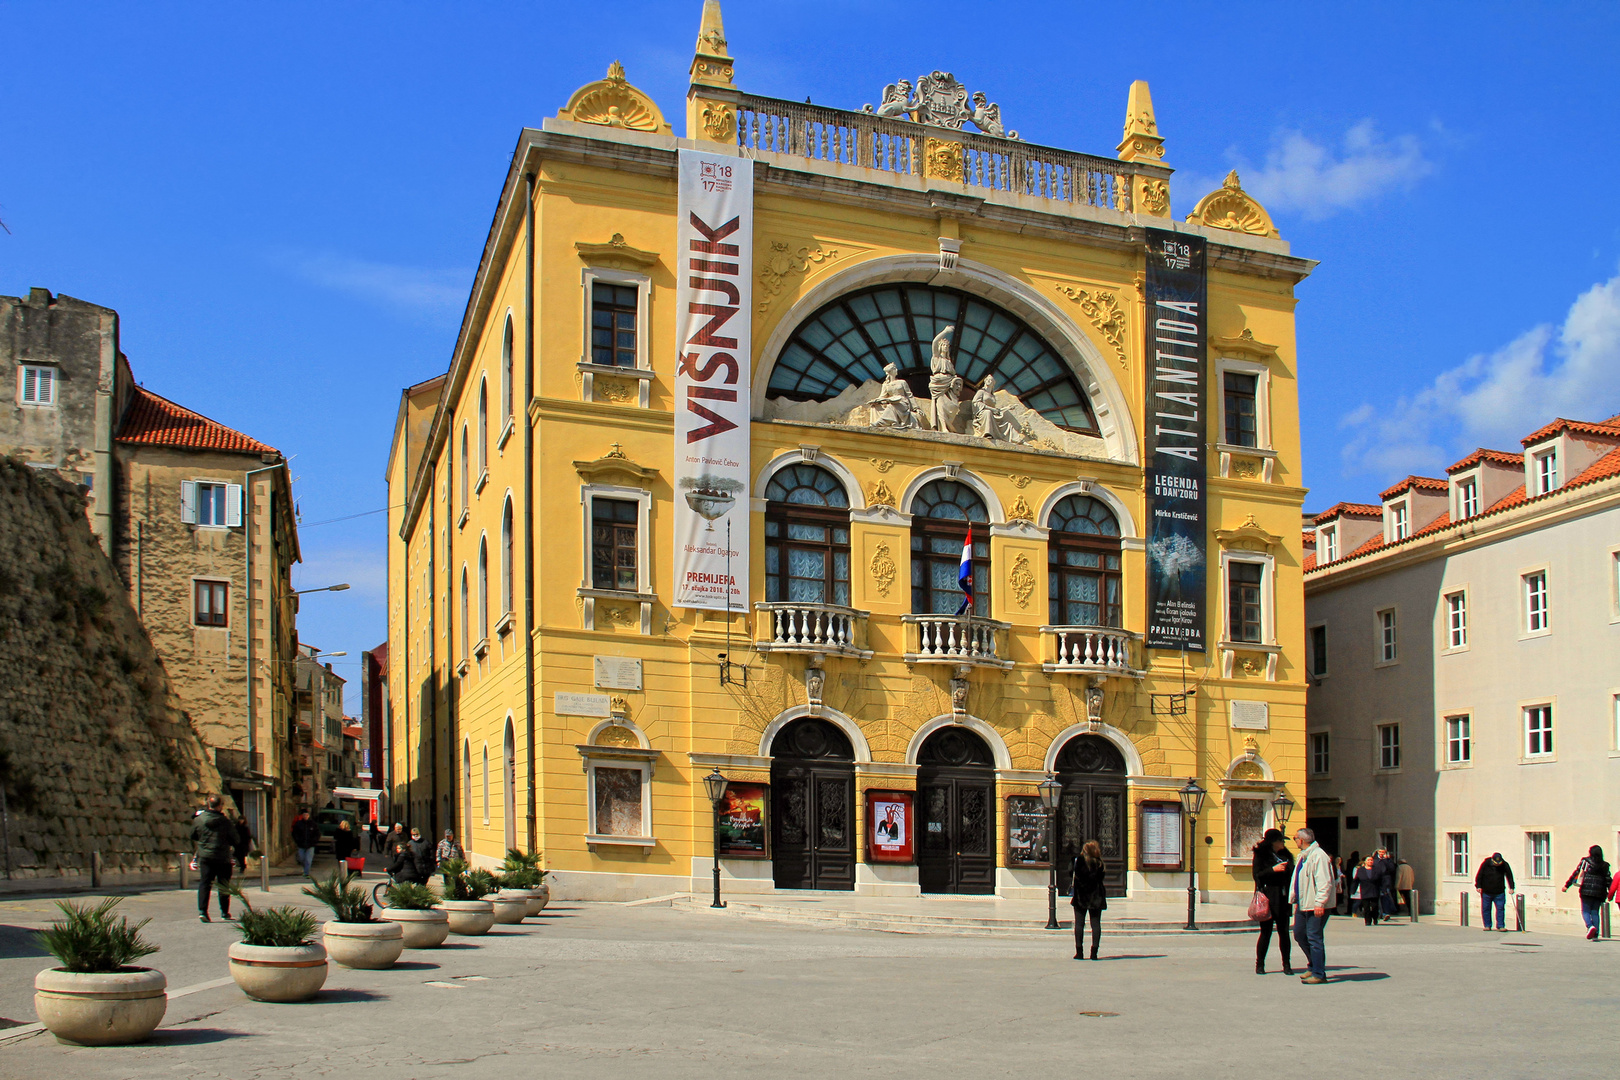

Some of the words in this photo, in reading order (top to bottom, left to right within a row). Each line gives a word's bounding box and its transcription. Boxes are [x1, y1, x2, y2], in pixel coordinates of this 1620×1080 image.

[717, 164, 732, 178] '18
[700, 177, 716, 193] '17
[1177, 243, 1190, 256] '18
[1163, 255, 1176, 270] '17
[678, 209, 740, 445] VIŠNJIK
[1155, 300, 1198, 462] ATLANTIDA
[685, 455, 701, 464] Anton
[723, 457, 740, 468] Čehov
[1155, 474, 1198, 490] LEGENDA
[1155, 486, 1160, 496] O
[1155, 509, 1171, 518] Mirko
[684, 544, 717, 555] Aleksandar
[687, 571, 736, 586] PREMIJERA
[691, 585, 709, 593] ožujka
[709, 586, 725, 594] 2018.
[1166, 600, 1177, 608] Alan
[1171, 616, 1181, 624] Igor
